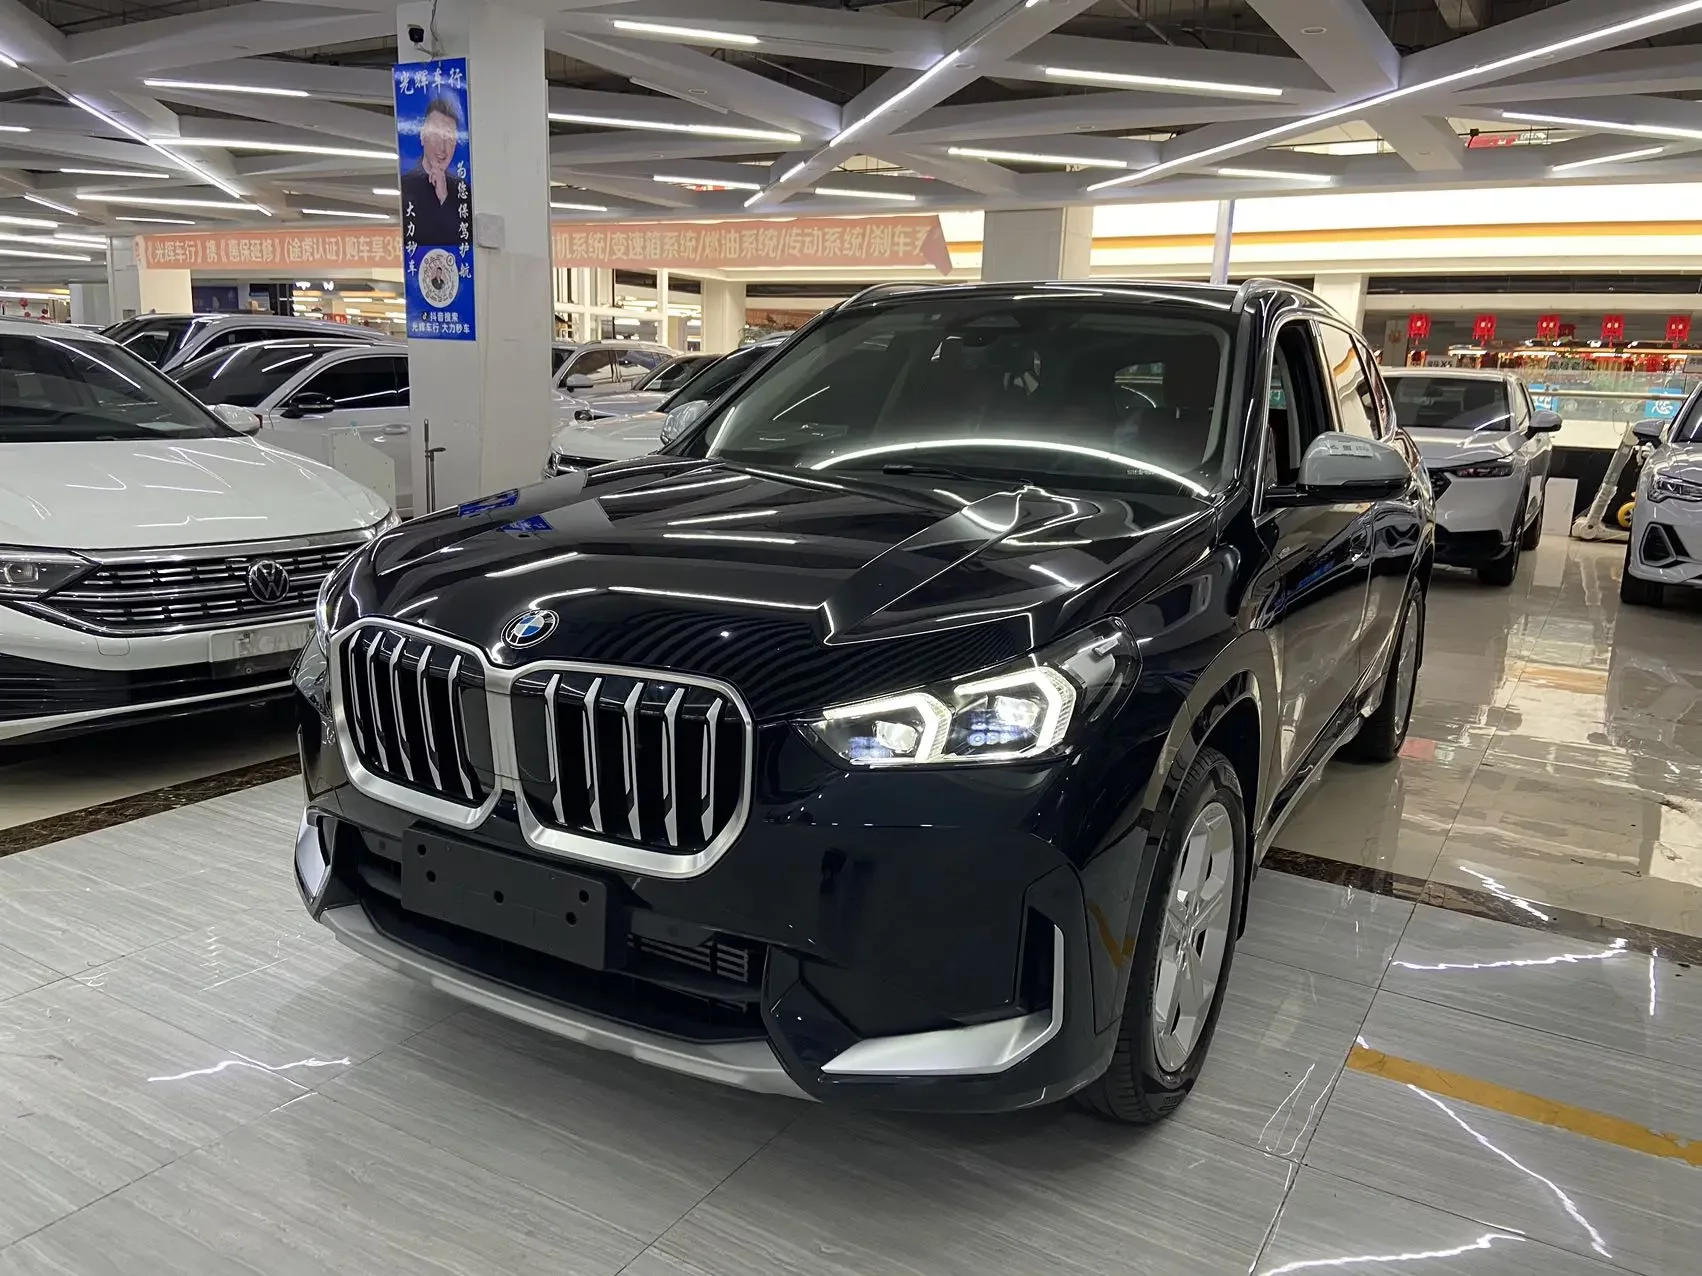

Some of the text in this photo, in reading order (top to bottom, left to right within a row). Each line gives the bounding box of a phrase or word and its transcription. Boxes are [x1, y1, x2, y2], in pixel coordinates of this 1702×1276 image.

[455, 160, 473, 279] 为您保驾护航
